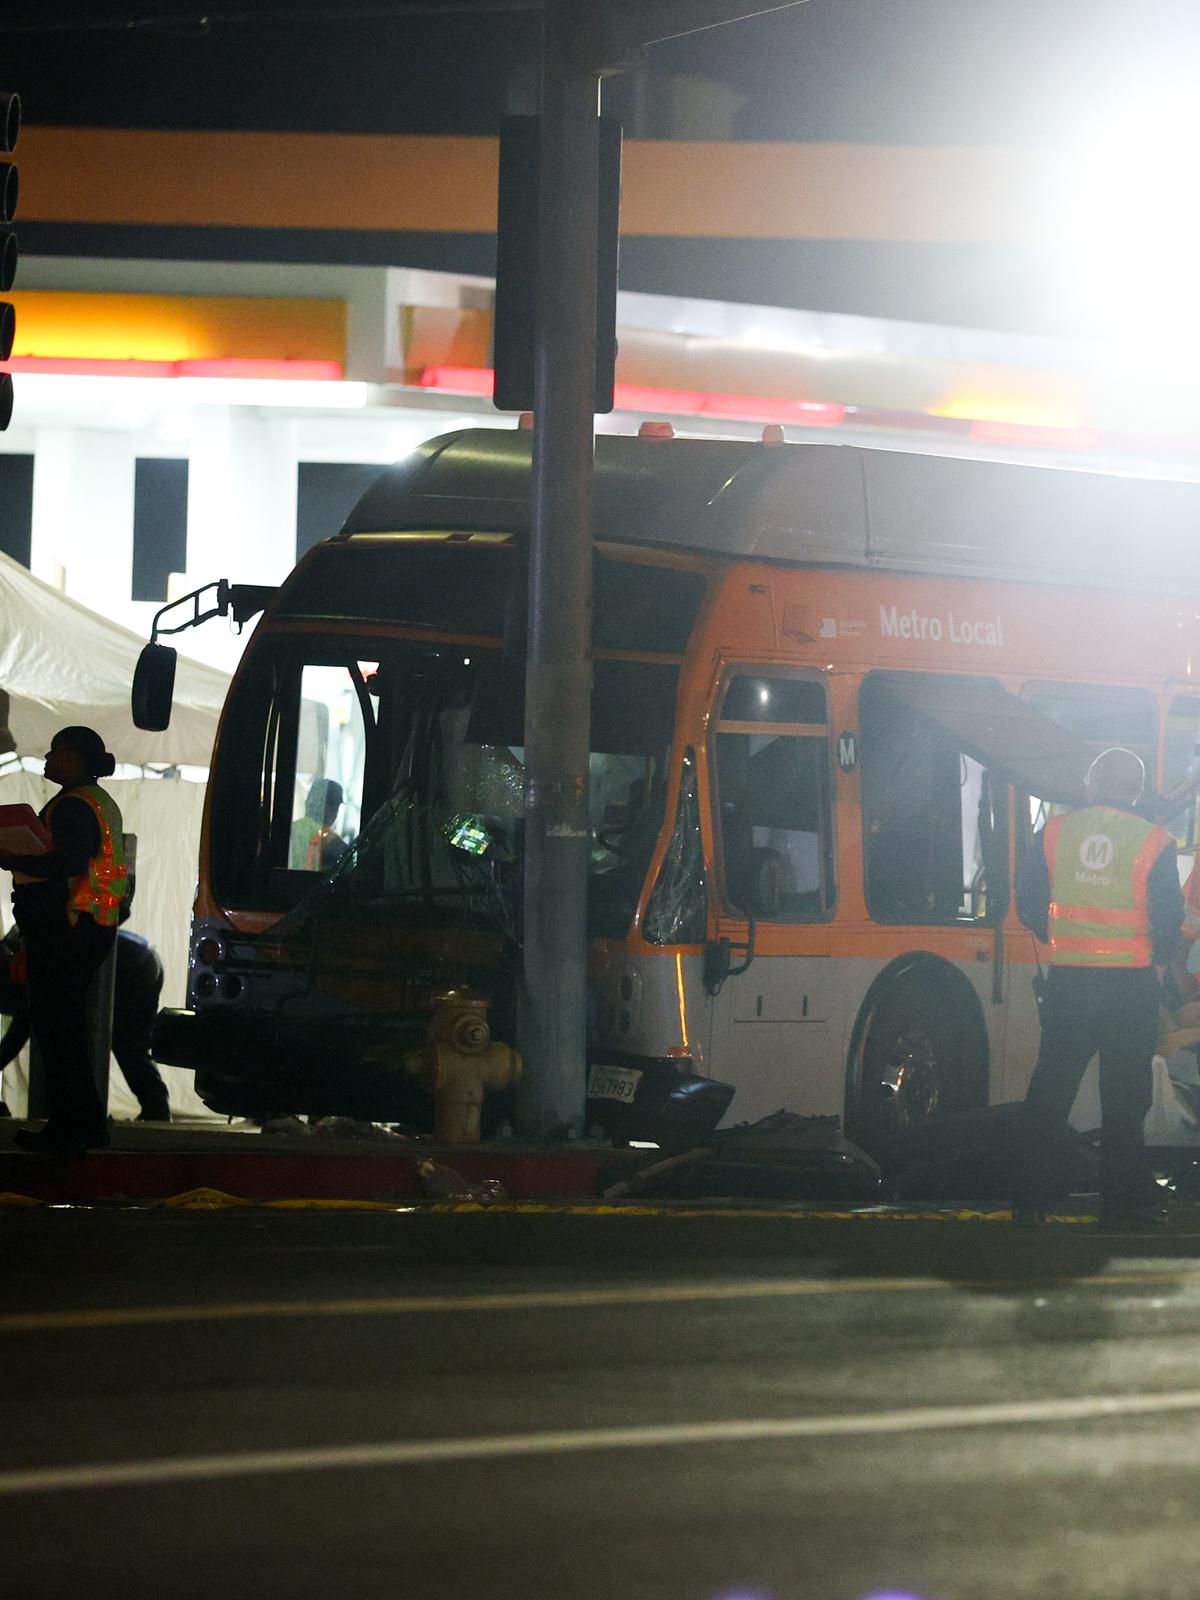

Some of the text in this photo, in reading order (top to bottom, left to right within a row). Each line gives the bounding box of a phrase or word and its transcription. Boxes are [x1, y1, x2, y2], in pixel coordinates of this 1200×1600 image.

[879, 603, 943, 641] Metro
[947, 607, 1005, 648] Local
[1074, 871, 1111, 887] Metro
